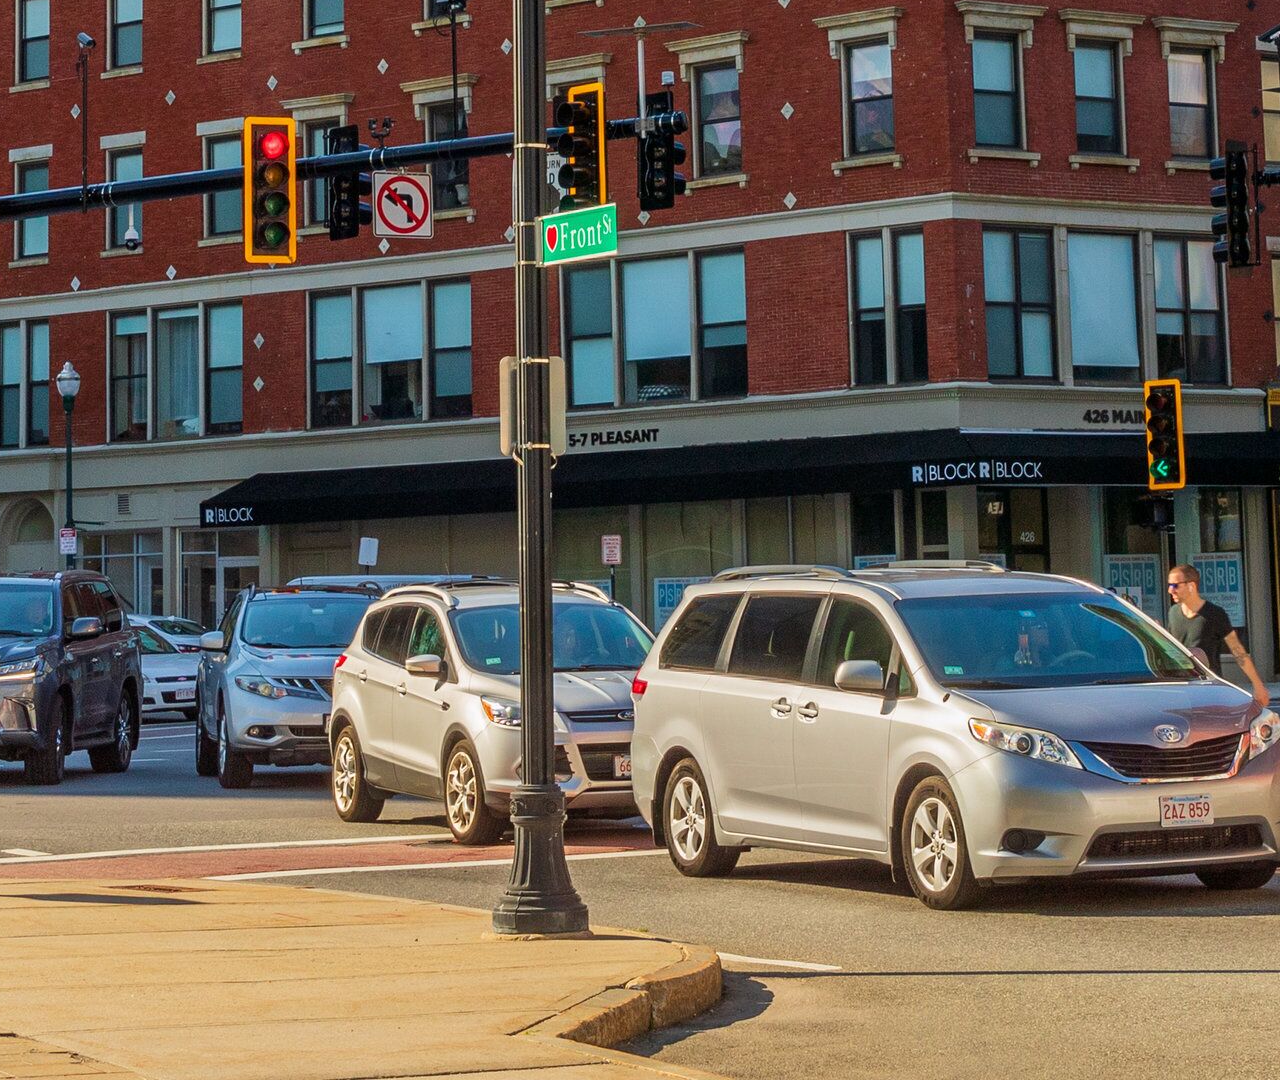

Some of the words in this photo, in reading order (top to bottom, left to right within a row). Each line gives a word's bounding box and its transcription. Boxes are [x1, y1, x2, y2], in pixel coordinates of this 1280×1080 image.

[559, 220, 603, 252] Front
[602, 213, 612, 236] St
[1082, 409, 1109, 424] 426
[1111, 410, 1146, 424] MAIN
[568, 433, 588, 448] 5-7
[590, 428, 659, 446] PLEASANT
[1019, 530, 1036, 544] 426
[1163, 803, 1186, 820] 2AZ
[1188, 801, 1210, 818] 859
